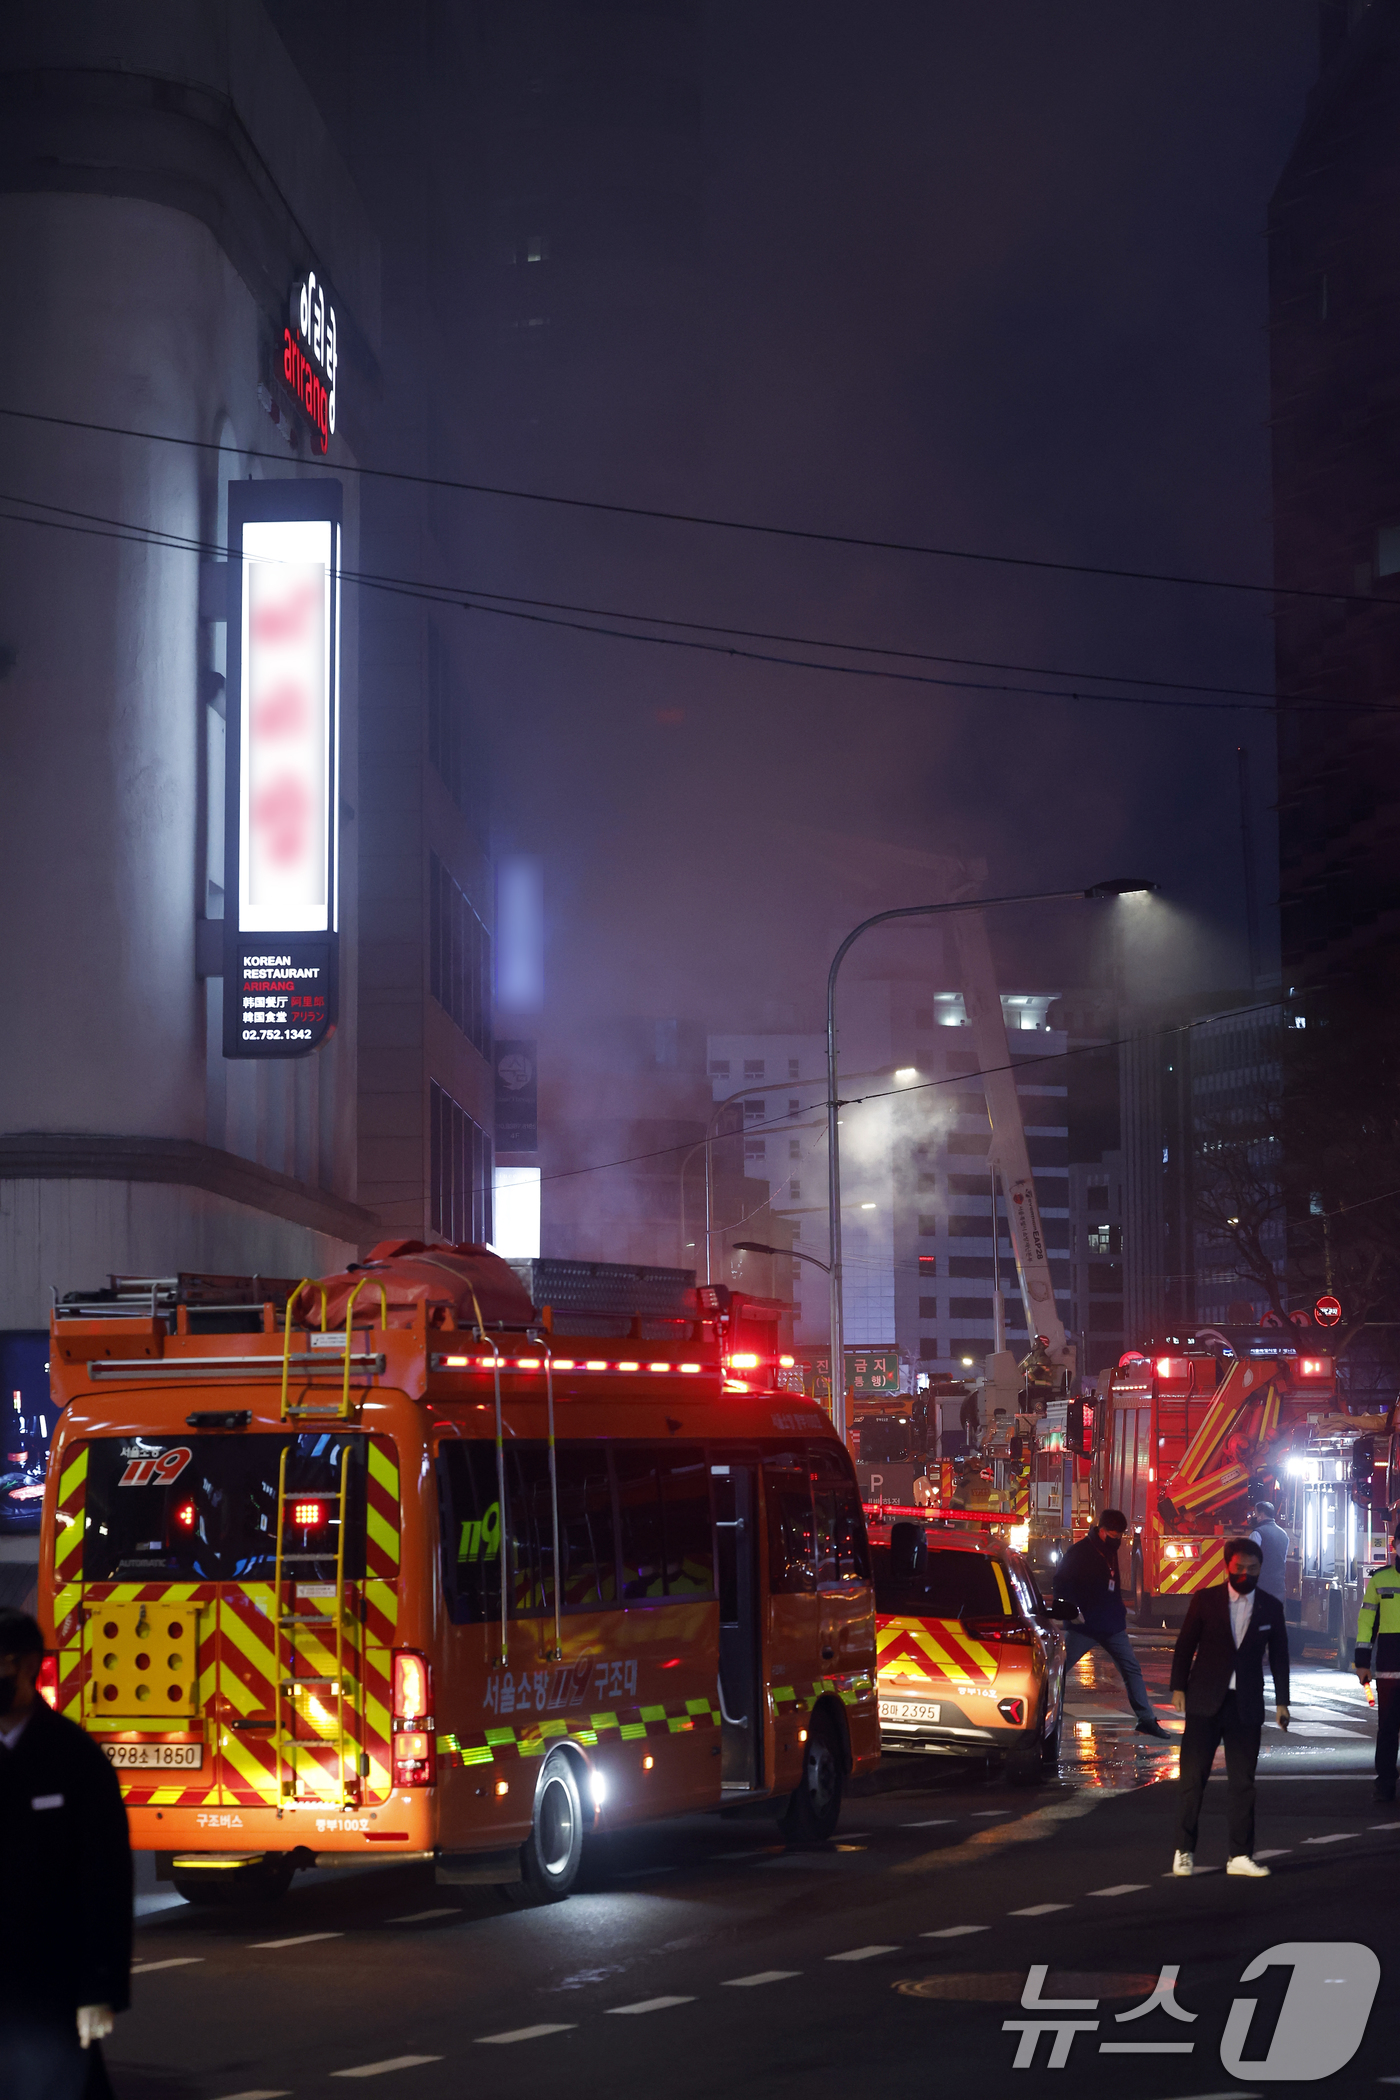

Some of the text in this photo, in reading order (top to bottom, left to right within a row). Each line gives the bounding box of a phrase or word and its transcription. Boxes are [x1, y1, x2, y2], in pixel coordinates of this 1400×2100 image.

[284, 327, 328, 455] arirang
[243, 956, 291, 966] KOREAN
[243, 968, 320, 979] RESTAURANT
[243, 981, 295, 991] ARIRANG
[242, 996, 288, 1008] 韩国餐厅
[291, 1012, 324, 1022] アリラン
[242, 1028, 312, 1040] 02.752.1342
[1032, 1230, 1044, 1260] EAP28
[118, 1446, 193, 1487] 119
[870, 1474, 884, 1493] P
[457, 1501, 501, 1563] 119
[118, 1558, 166, 1568] AUTOMATIC
[482, 1648, 638, 1715] 서울소방 119 구조대
[879, 1703, 935, 1719] 8마 2395
[154, 1747, 194, 1764] 1850
[196, 1814, 244, 1828] 구조버스
[316, 1818, 370, 1832] 중부100호
